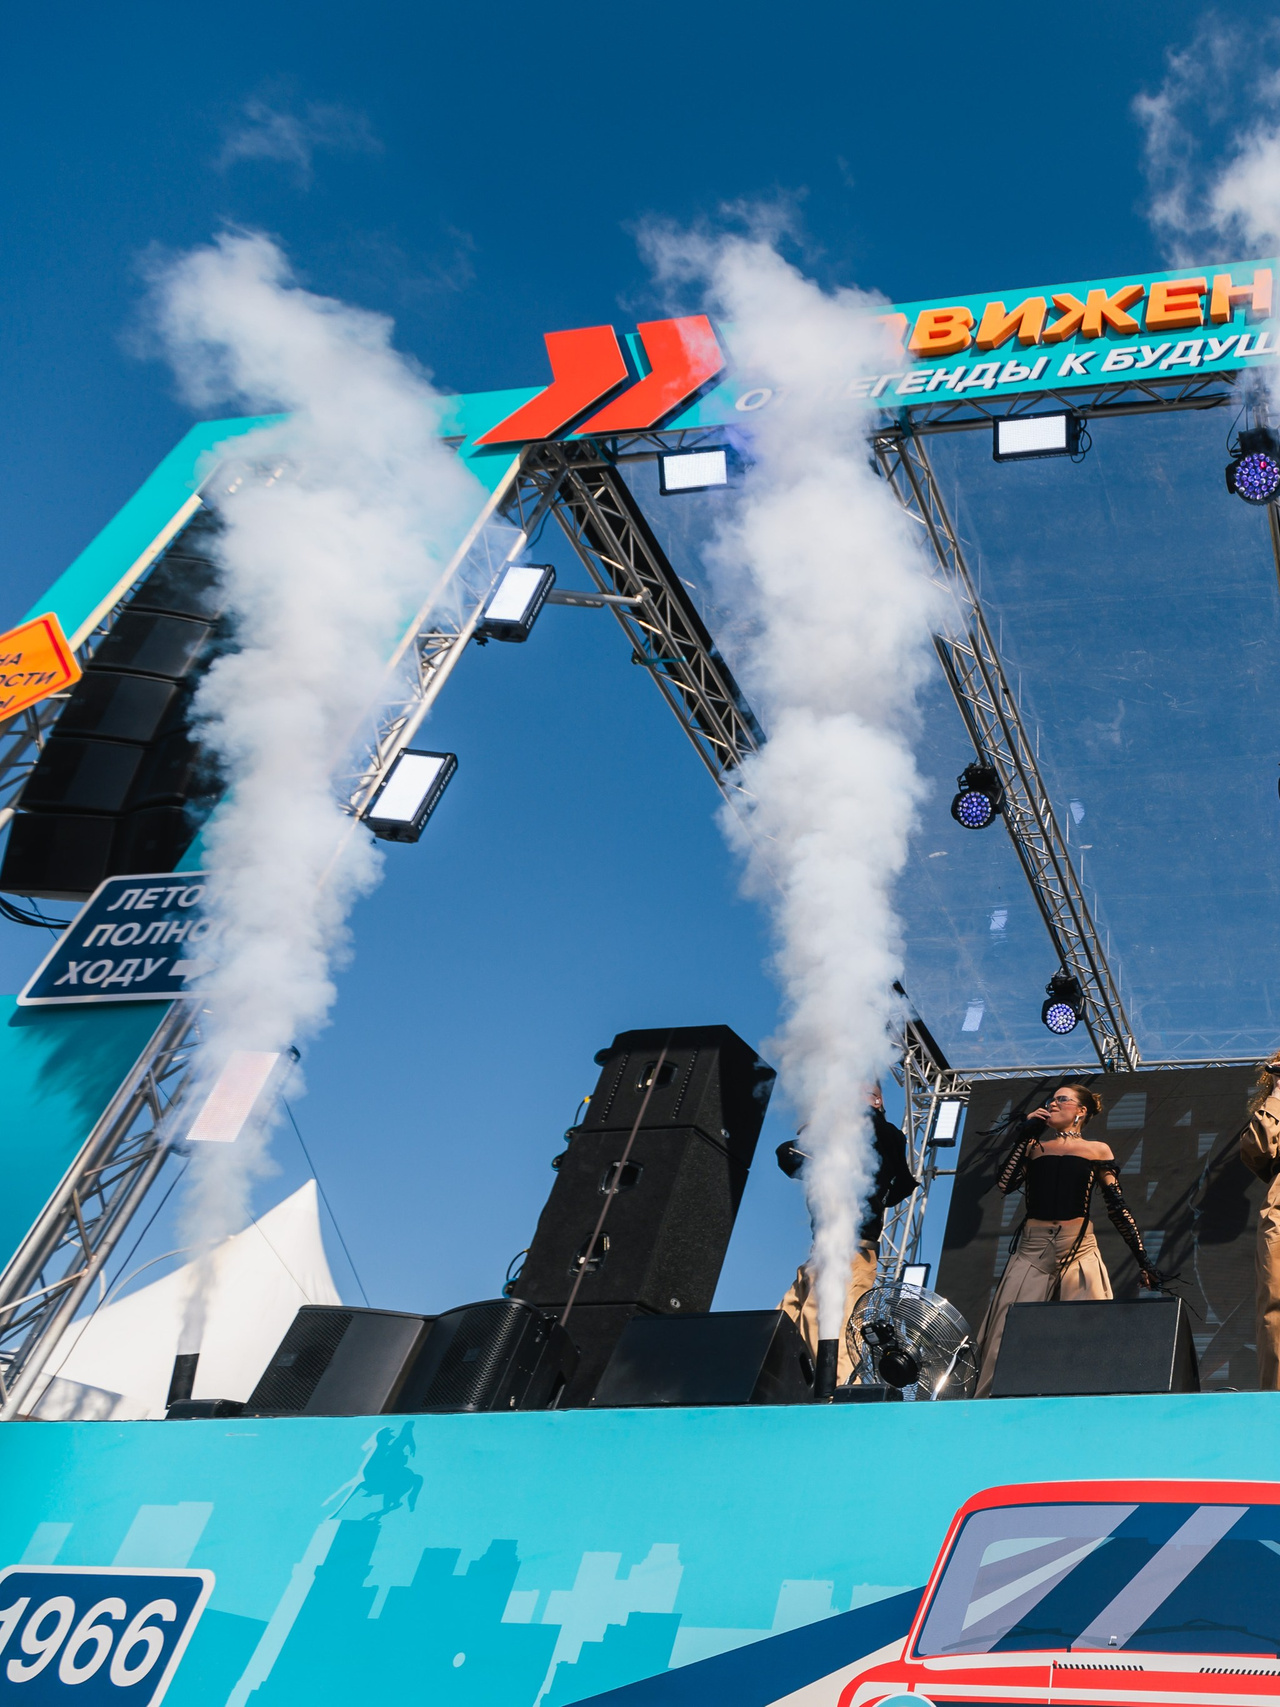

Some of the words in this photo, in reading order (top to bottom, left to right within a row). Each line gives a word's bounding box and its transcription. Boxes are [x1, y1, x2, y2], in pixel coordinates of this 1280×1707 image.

[842, 355, 1047, 400] ЕГЕНДЫ
[1057, 351, 1095, 377] К
[107, 884, 207, 912] ЛЕТО
[54, 957, 168, 988] ХОДУ
[0, 1596, 177, 1687] 1966
